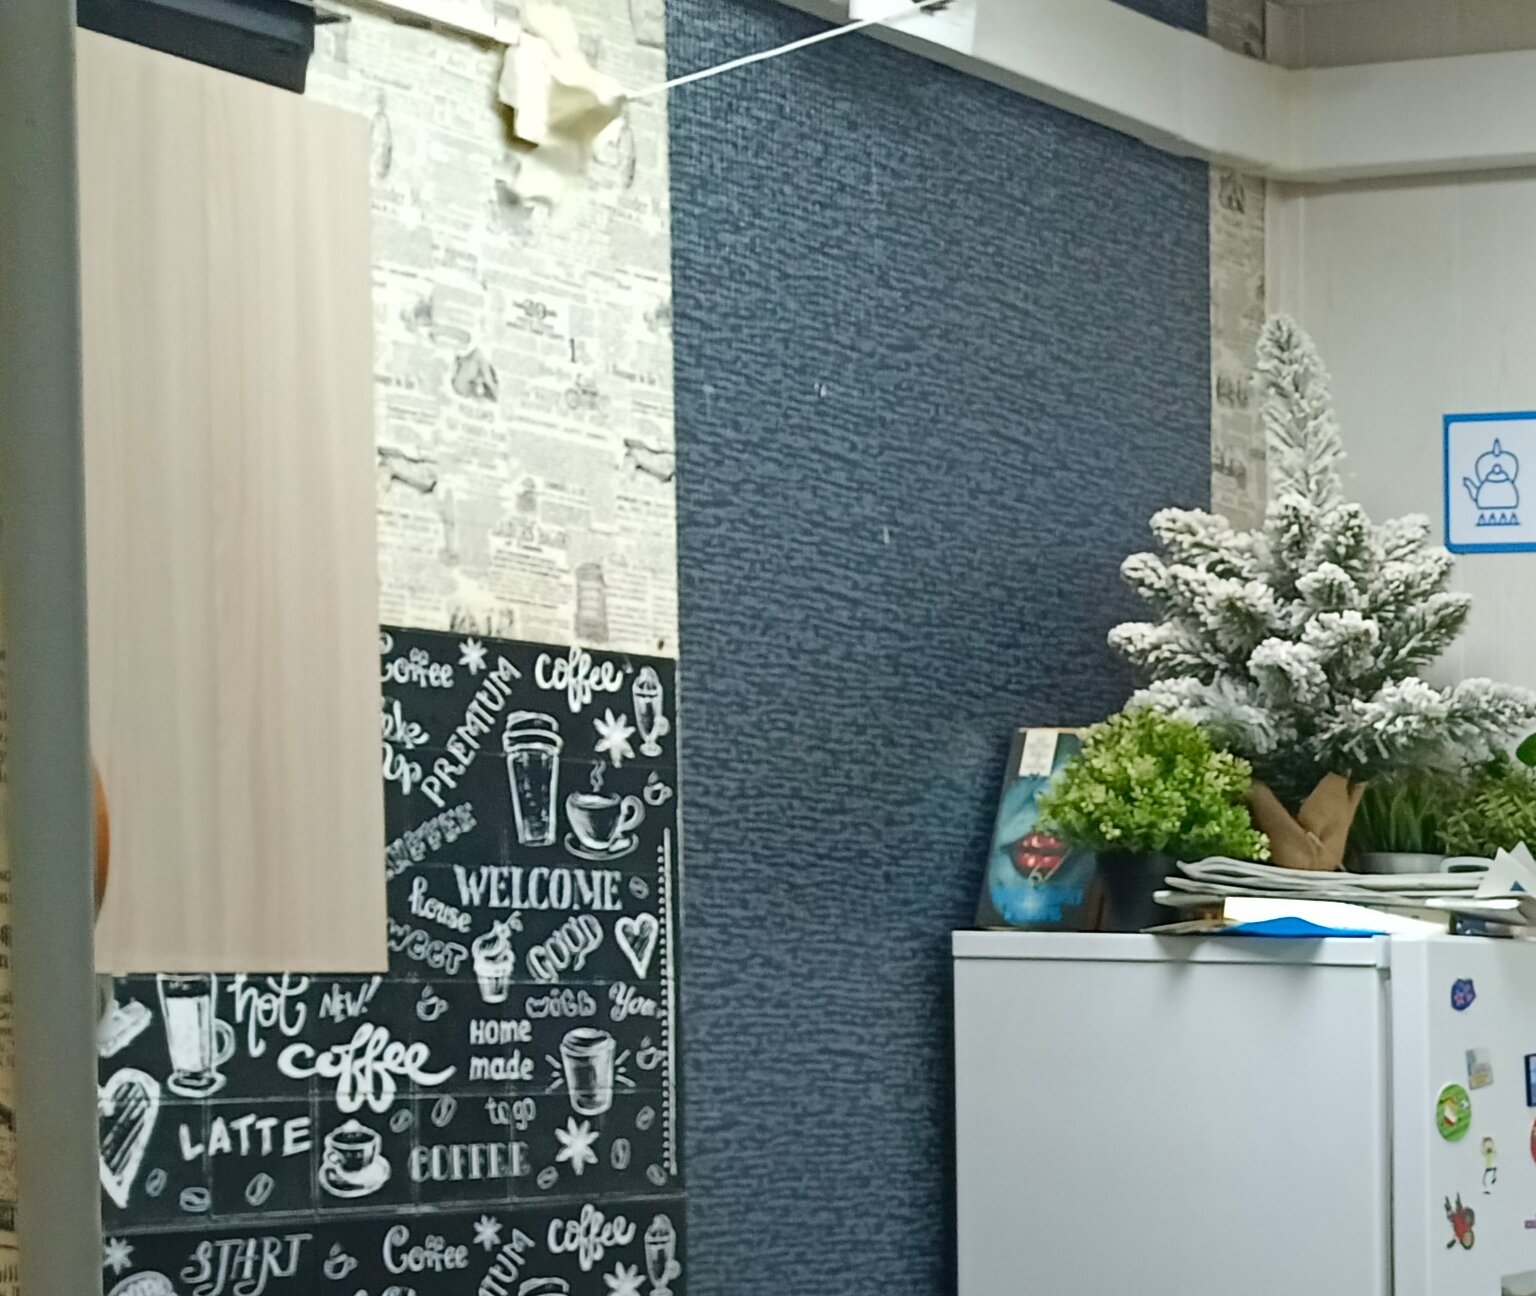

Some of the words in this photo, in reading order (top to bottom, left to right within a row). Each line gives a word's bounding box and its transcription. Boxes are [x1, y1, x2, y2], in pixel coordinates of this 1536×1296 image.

[420, 656, 522, 808] PREMIUM
[408, 875, 472, 933] house
[453, 864, 623, 911] WELCOME
[318, 976, 383, 1023] NEW!
[277, 1022, 456, 1113] coffee
[469, 1049, 535, 1081] made
[179, 1113, 313, 1161] LATTE
[408, 1141, 530, 1182] COFFEE
[383, 1225, 469, 1274] Coffee
